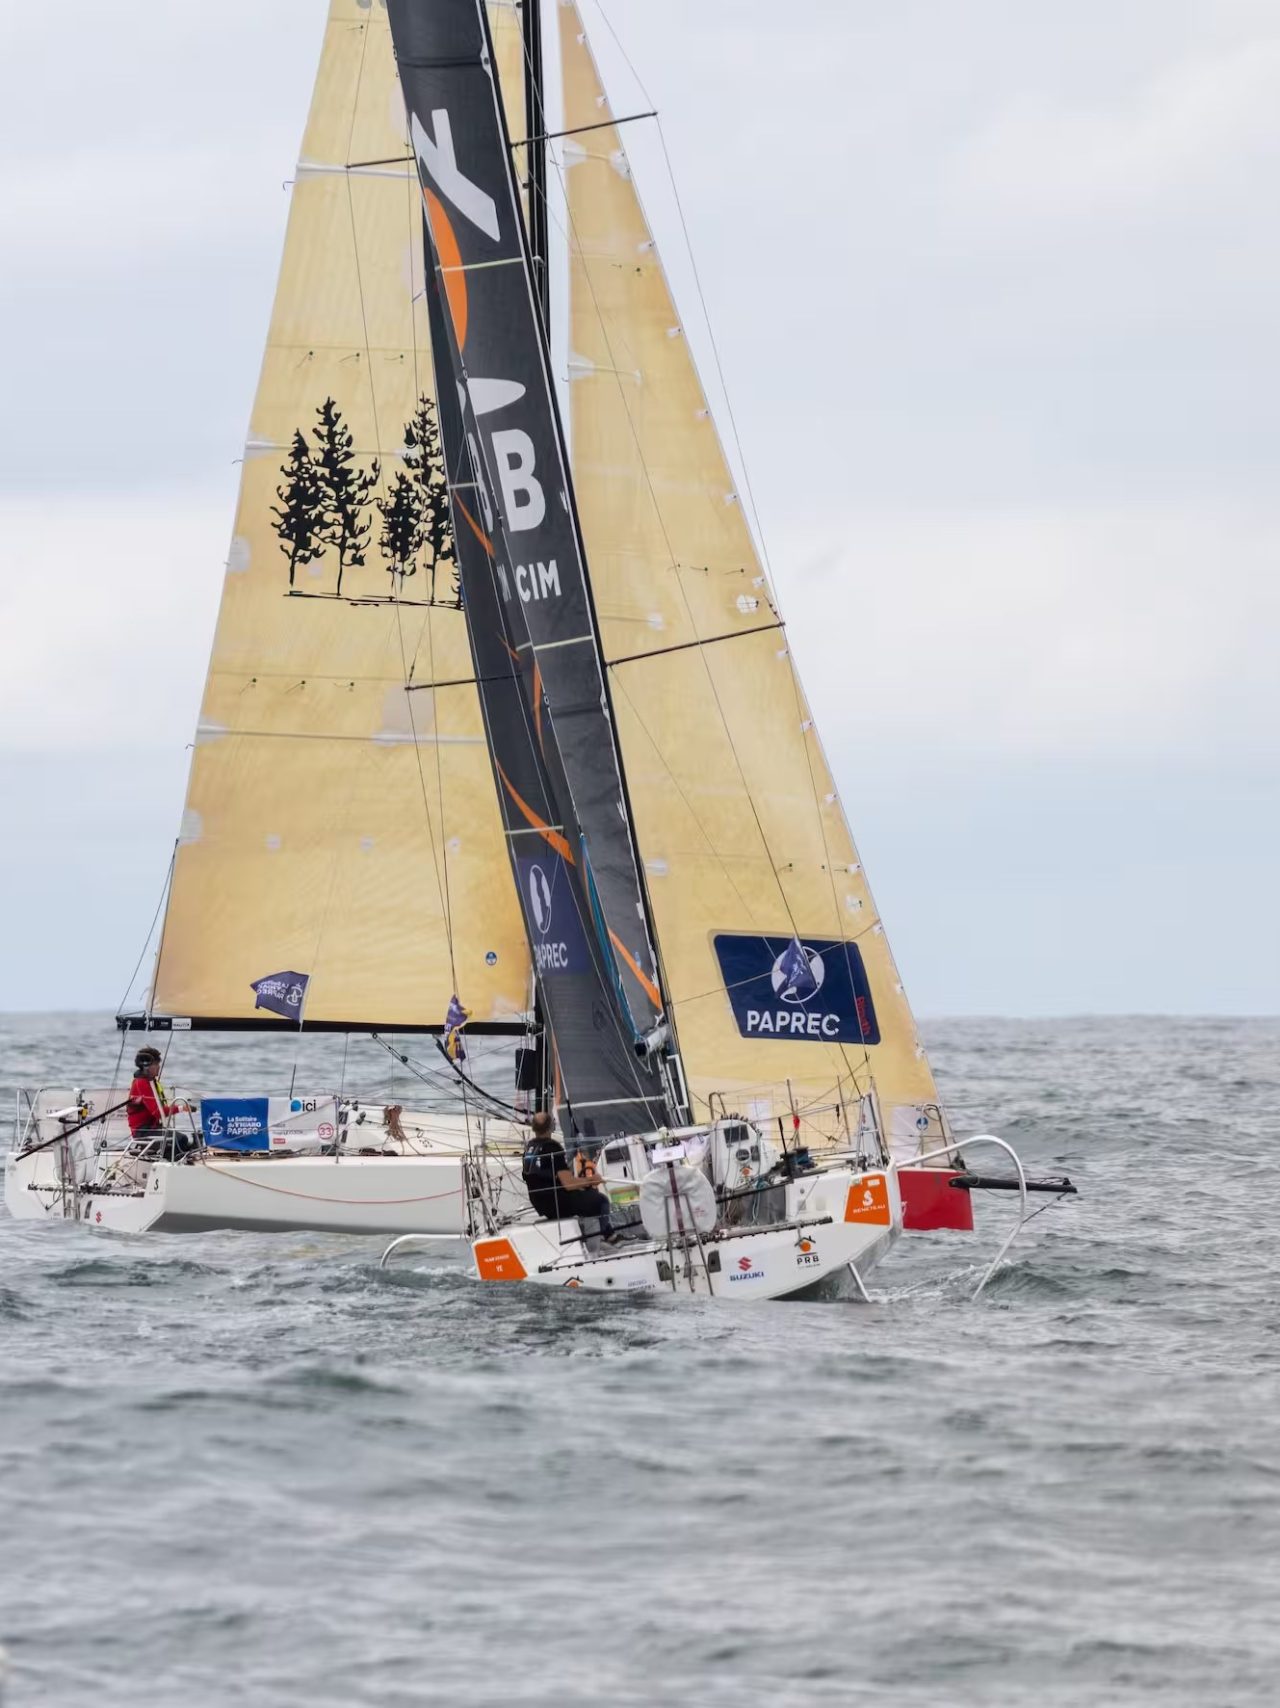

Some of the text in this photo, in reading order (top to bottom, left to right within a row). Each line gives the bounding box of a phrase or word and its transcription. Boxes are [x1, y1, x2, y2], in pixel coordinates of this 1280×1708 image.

[746, 1010, 840, 1036] PAPREC
[302, 1100, 317, 1112] ici
[227, 1127, 258, 1135] PAPREC
[319, 1126, 331, 1136] 33
[796, 1255, 819, 1265] PRB
[729, 1271, 764, 1282] SUZUKI
